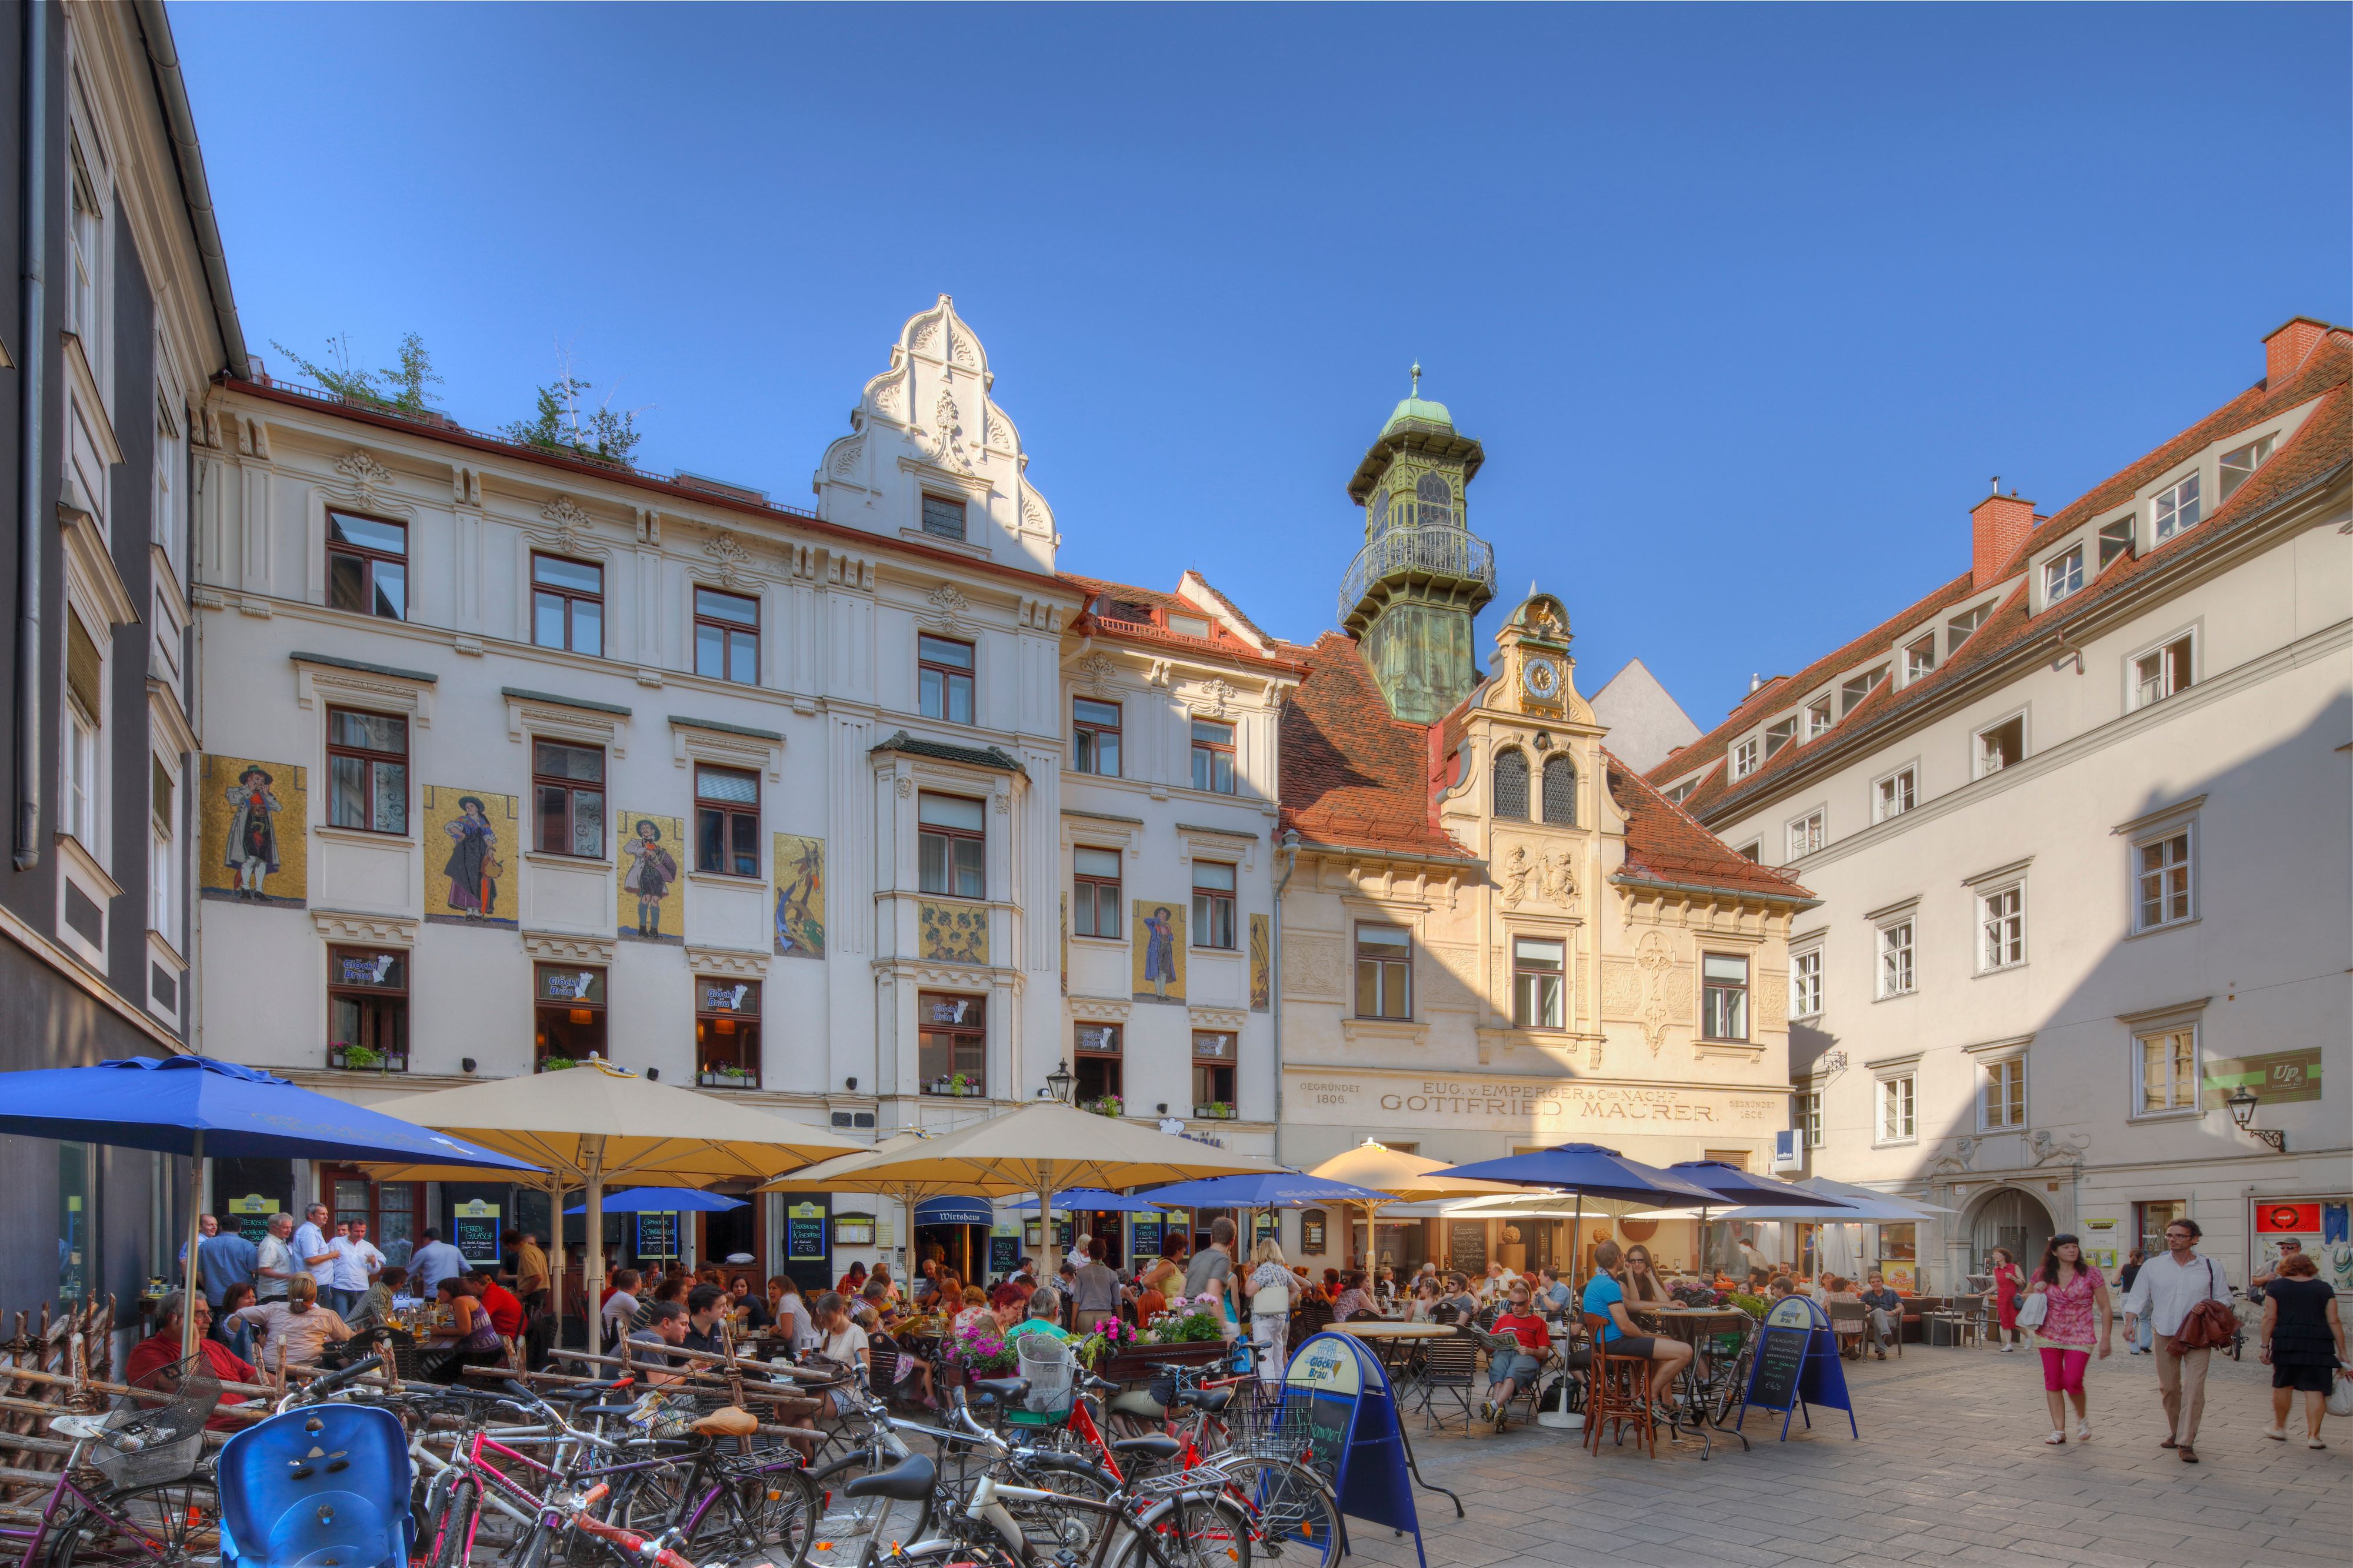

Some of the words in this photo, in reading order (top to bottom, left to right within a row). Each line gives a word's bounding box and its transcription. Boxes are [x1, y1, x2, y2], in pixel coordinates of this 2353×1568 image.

[344, 959, 377, 970] Glöckl
[344, 970, 371, 980] Bräu
[549, 976, 580, 986] Glöckl
[550, 986, 574, 996] Bräu
[708, 988, 735, 998] Glöckl
[708, 998, 729, 1007] Bräu
[933, 1003, 957, 1013] Glöckl
[934, 1012, 953, 1021] Bräu
[2274, 1065, 2298, 1082] Up
[1300, 1082, 1360, 1092] GEGRÜNDET
[1423, 1082, 1465, 1095] EUG.
[1482, 1085, 1584, 1099] EMPERGER
[1317, 1095, 1348, 1104] 1806.
[1729, 1100, 1775, 1109] GEGRÜNDET
[1381, 1094, 1562, 1116] GOTTFRIED
[1581, 1102, 1719, 1122] MAURER.
[939, 1213, 980, 1222] Wirtshaus
[465, 1232, 494, 1240] GULASCH
[1309, 1356, 1334, 1369] Glöckl
[1308, 1367, 1328, 1380] Bräu
